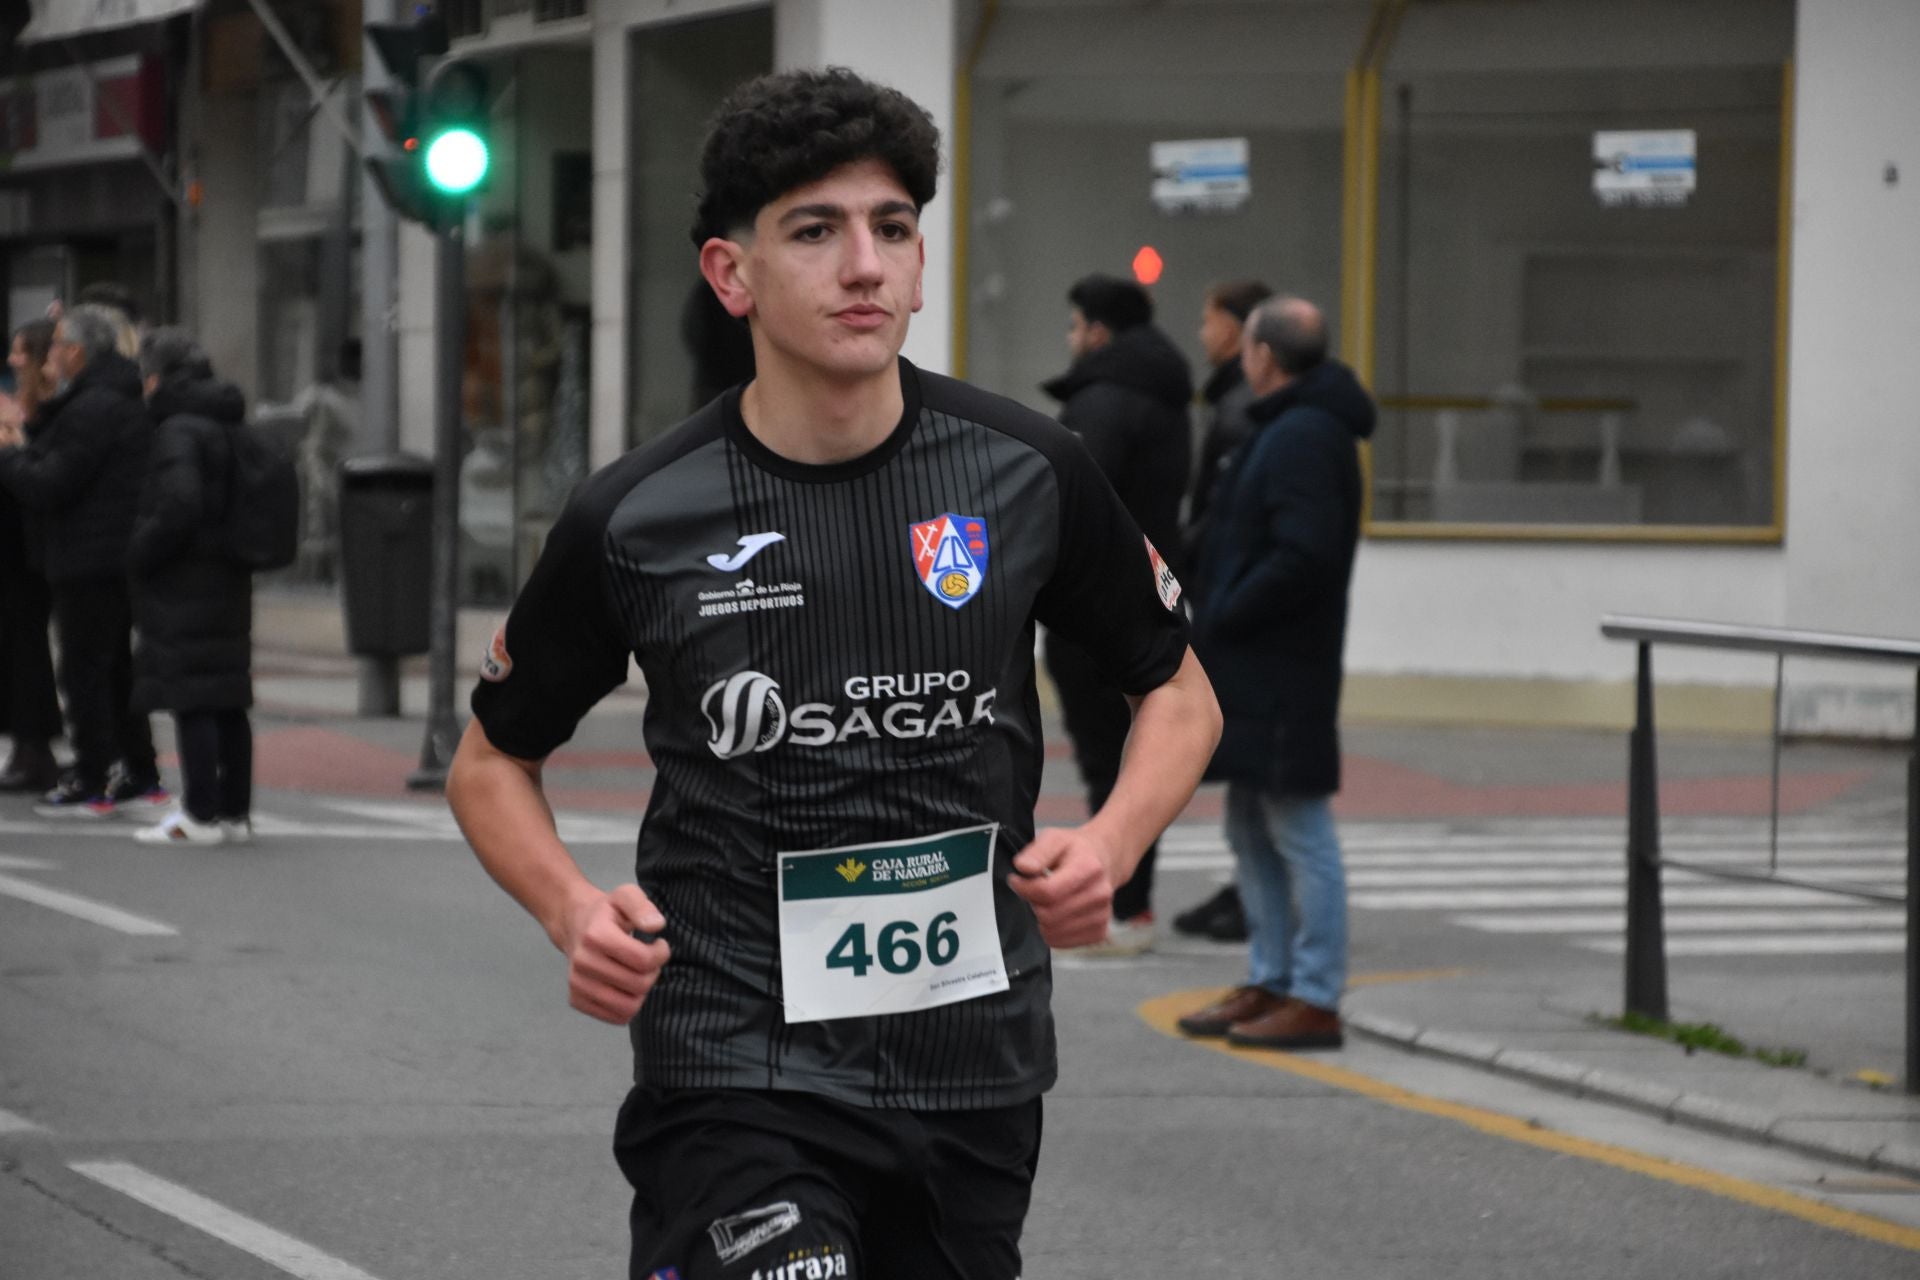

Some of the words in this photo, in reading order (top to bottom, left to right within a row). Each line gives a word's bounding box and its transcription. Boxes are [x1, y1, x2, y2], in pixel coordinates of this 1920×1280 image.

[698, 589, 736, 601] Gobierno
[756, 585, 768, 594] de
[768, 584, 780, 593] La
[780, 582, 802, 593] Rioja
[699, 601, 740, 617] JUEGOS
[740, 594, 805, 612] DEPORTIVOS
[844, 669, 971, 700] GRUPO
[872, 858, 904, 871] CAJA
[906, 850, 946, 868] RURAL
[872, 870, 892, 882] DE
[894, 860, 950, 881] NAVARRA
[826, 911, 960, 977] 466
